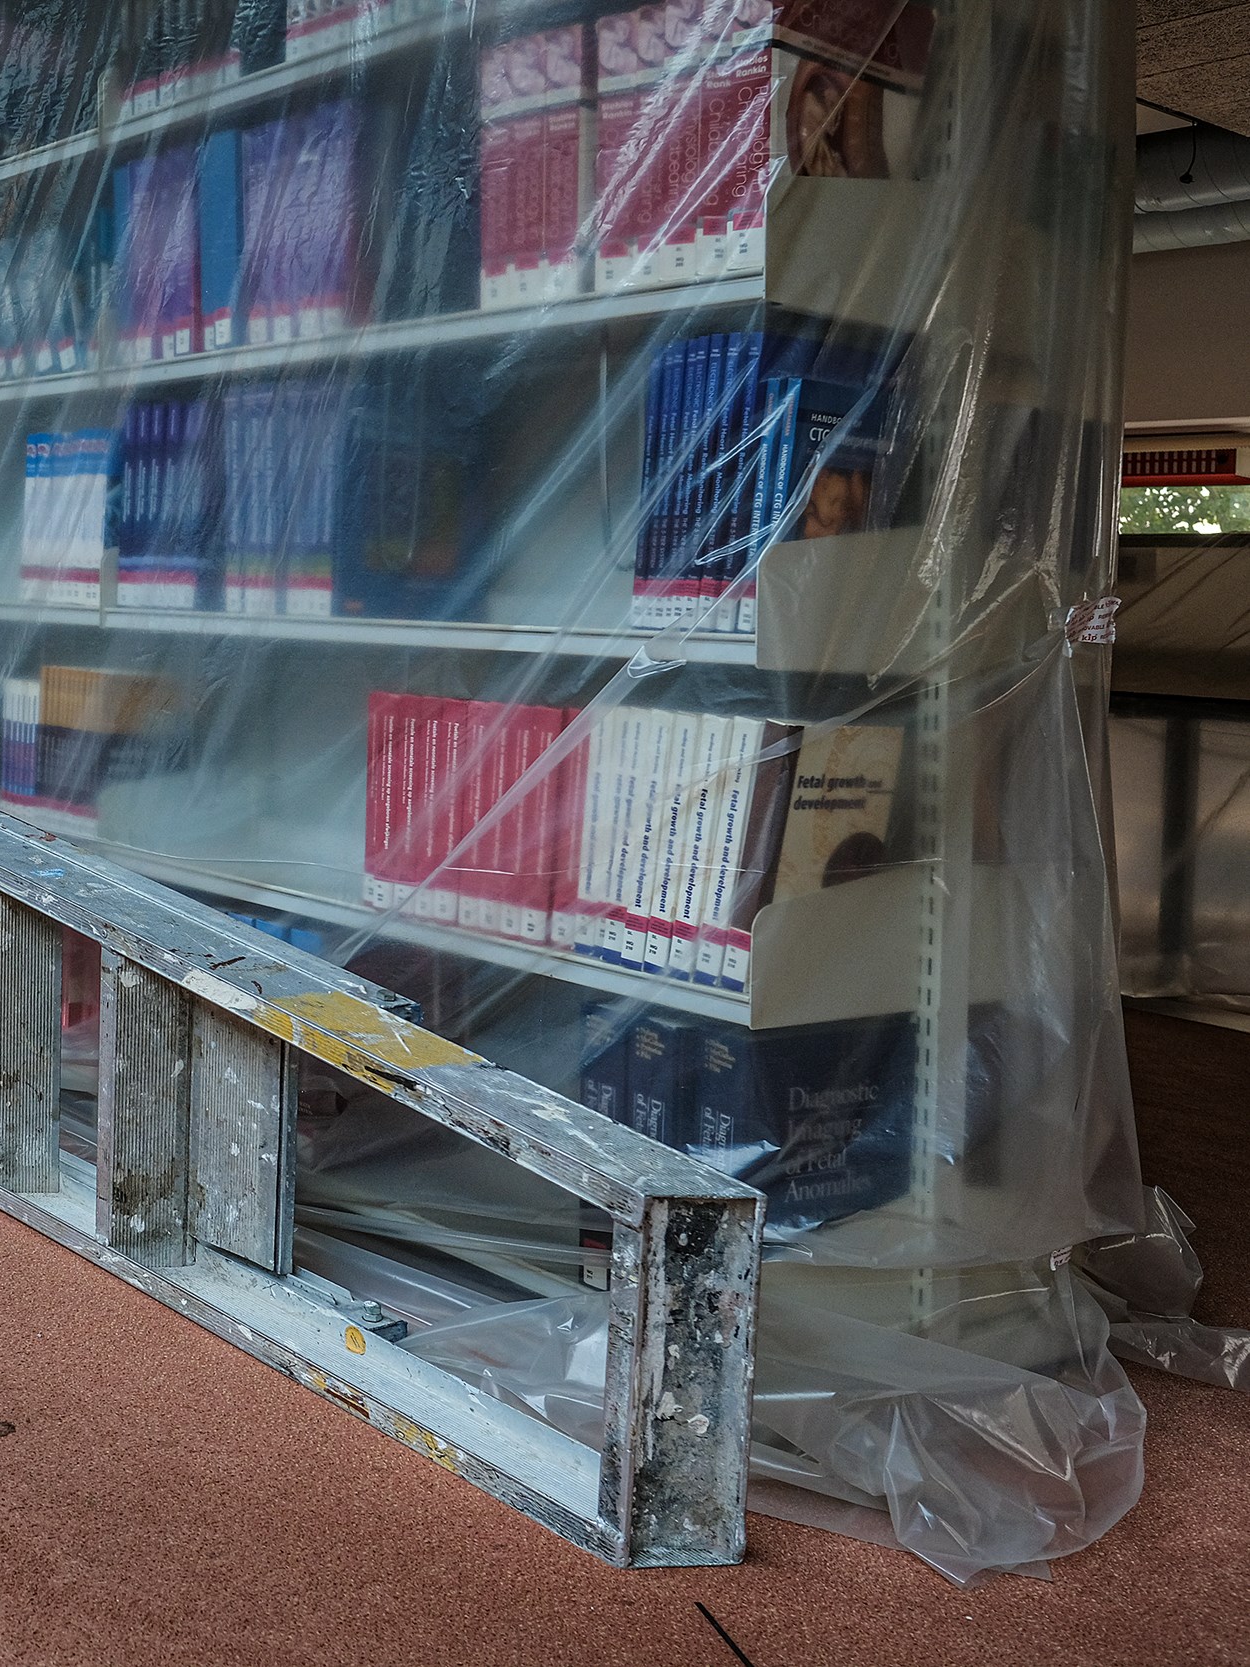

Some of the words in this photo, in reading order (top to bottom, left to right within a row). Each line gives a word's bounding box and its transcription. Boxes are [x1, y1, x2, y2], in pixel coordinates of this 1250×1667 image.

[736, 65, 767, 78] Rankin
[758, 443, 769, 480] HANDBOOK
[777, 444, 789, 480] HANDBOOK
[710, 471, 722, 514] Monitoring
[753, 492, 764, 508] CTG
[772, 492, 784, 508] CTG
[1081, 633, 1098, 642] kip
[797, 774, 825, 789] Fetal
[827, 774, 866, 792] growth
[699, 788, 708, 810] Fetal
[730, 789, 739, 811] Fetal
[793, 795, 866, 813] development
[669, 806, 678, 837] growth
[694, 811, 704, 842] growth
[725, 813, 735, 844] growth
[642, 834, 650, 851] and
[722, 845, 730, 863] and
[616, 848, 629, 902] development
[634, 853, 648, 908] development
[659, 857, 673, 913] development
[683, 862, 698, 919] development
[712, 864, 729, 920] development
[789, 1083, 879, 1113] Diagnostic
[703, 1106, 715, 1122] of
